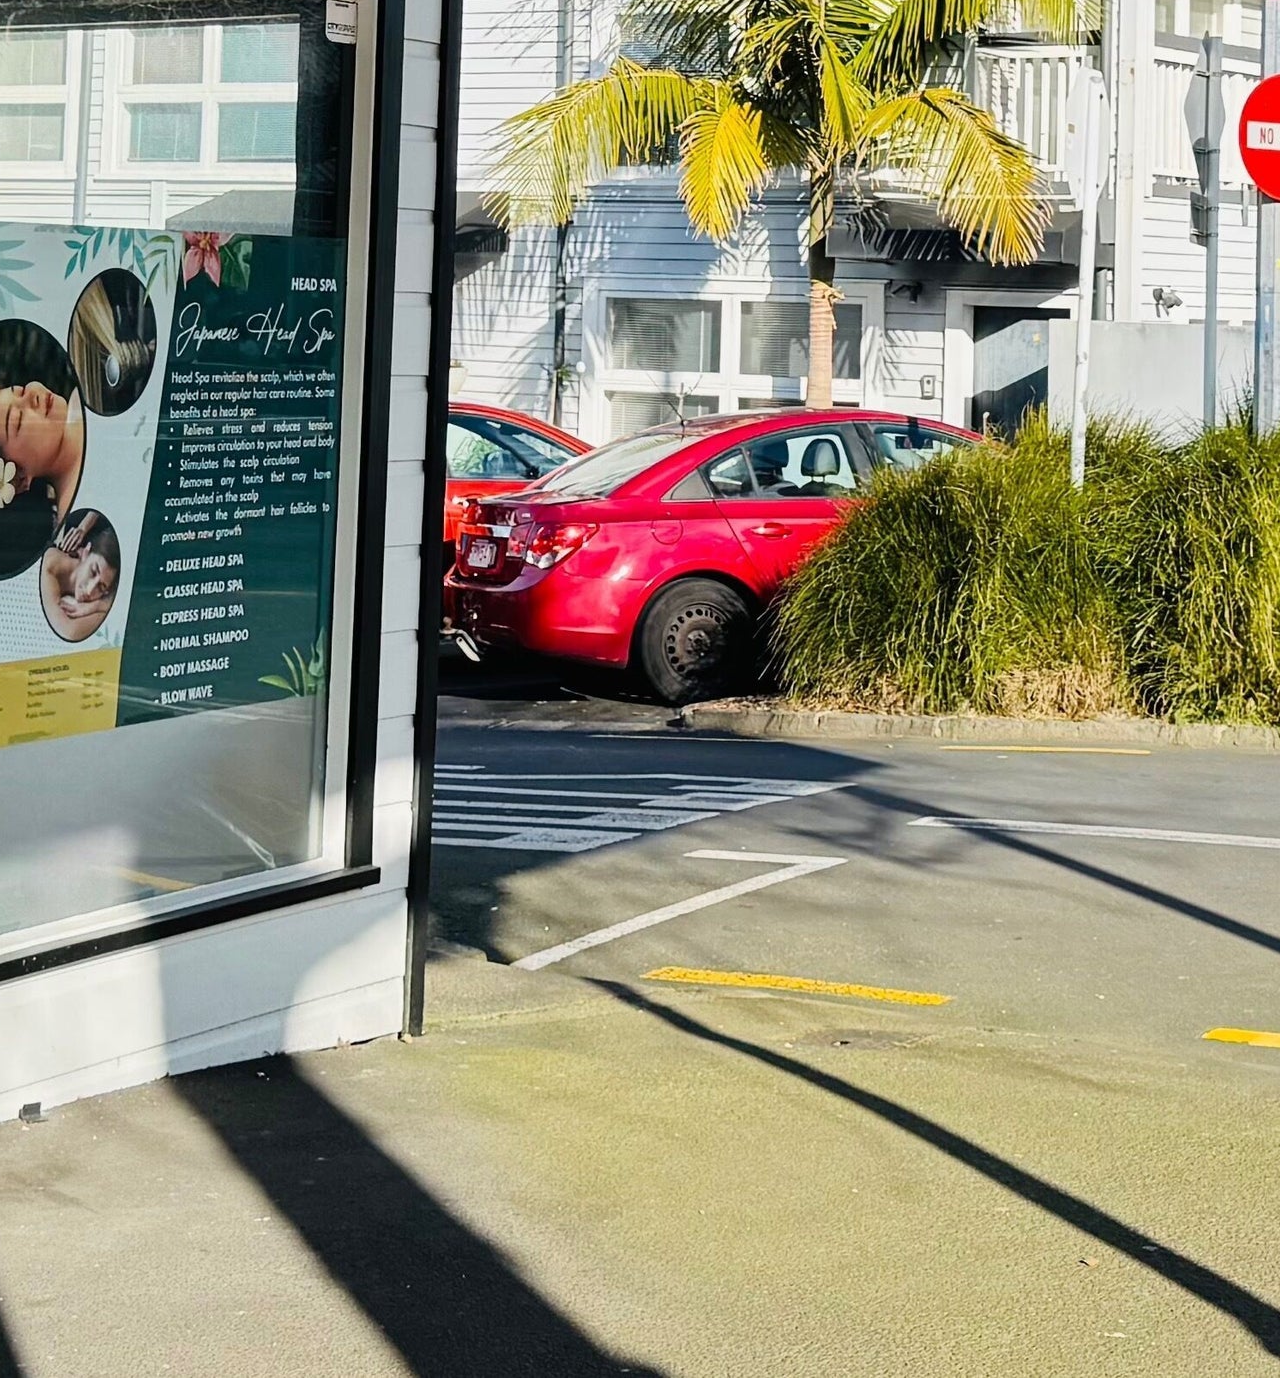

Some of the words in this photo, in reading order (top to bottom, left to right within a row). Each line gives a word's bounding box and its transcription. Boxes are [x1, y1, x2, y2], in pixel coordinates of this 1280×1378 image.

[1260, 127, 1274, 145] NO
[291, 277, 318, 291] HEAD
[320, 278, 338, 292] SPA
[176, 302, 240, 357] Japanese
[246, 303, 302, 355] Head
[303, 308, 335, 354] Spa
[171, 372, 193, 383] Head
[194, 372, 210, 385] Spa
[212, 371, 245, 383] revitalize
[246, 371, 259, 383] the
[283, 370, 304, 382] which
[306, 373, 316, 382] we
[317, 370, 336, 382] often
[170, 389, 199, 404] neglect
[201, 389, 209, 400] in
[210, 391, 223, 400] our
[224, 388, 252, 403] regular
[253, 387, 268, 399] hair
[269, 390, 286, 399] care
[315, 386, 336, 398] Some
[170, 406, 200, 419] benefits
[202, 406, 211, 418] of
[212, 408, 217, 418] a
[219, 405, 239, 417] head
[183, 423, 214, 436] Relieves
[222, 423, 243, 434] stress
[251, 421, 266, 433] and
[273, 421, 301, 432] reduces
[308, 420, 333, 431] tension
[181, 441, 216, 455] Improves
[217, 439, 255, 451] circulation
[257, 439, 265, 450] to
[266, 440, 282, 452] your
[283, 437, 301, 448] head
[303, 436, 316, 447] and
[317, 435, 335, 449] body
[180, 458, 219, 471] Stimulates
[223, 457, 235, 468] the
[240, 455, 259, 468] scalp
[263, 455, 300, 467] circulation
[179, 476, 213, 488] Removes
[221, 477, 235, 488] any
[271, 470, 285, 482] that
[292, 472, 307, 483] may
[314, 469, 332, 480] have
[165, 491, 214, 507] accumulated
[216, 492, 223, 503] in
[225, 491, 238, 503] the
[240, 489, 259, 503] scalp
[175, 510, 210, 524] Activates
[215, 509, 228, 520] the
[234, 507, 266, 519] dormant
[271, 504, 285, 516] hair
[290, 502, 317, 514] follicles
[322, 502, 330, 512] to
[162, 531, 196, 545] promote
[197, 530, 215, 540] new
[215, 524, 242, 541] growth
[166, 557, 201, 573] DELUXE
[202, 555, 226, 569] HEAD
[227, 553, 244, 567] SPA
[164, 583, 199, 599] CLASSIC
[200, 580, 225, 595] HEAD
[226, 579, 243, 592] SPA
[161, 609, 199, 625] EXPRESS
[200, 607, 226, 621] HEAD
[228, 604, 244, 617] SPA
[160, 635, 201, 652] NORMAL
[203, 628, 249, 646] SHAMPOO
[160, 663, 186, 678] BODY
[187, 657, 230, 674] MASSAGE
[160, 689, 187, 705] BLOW
[188, 684, 213, 700] WAVE
